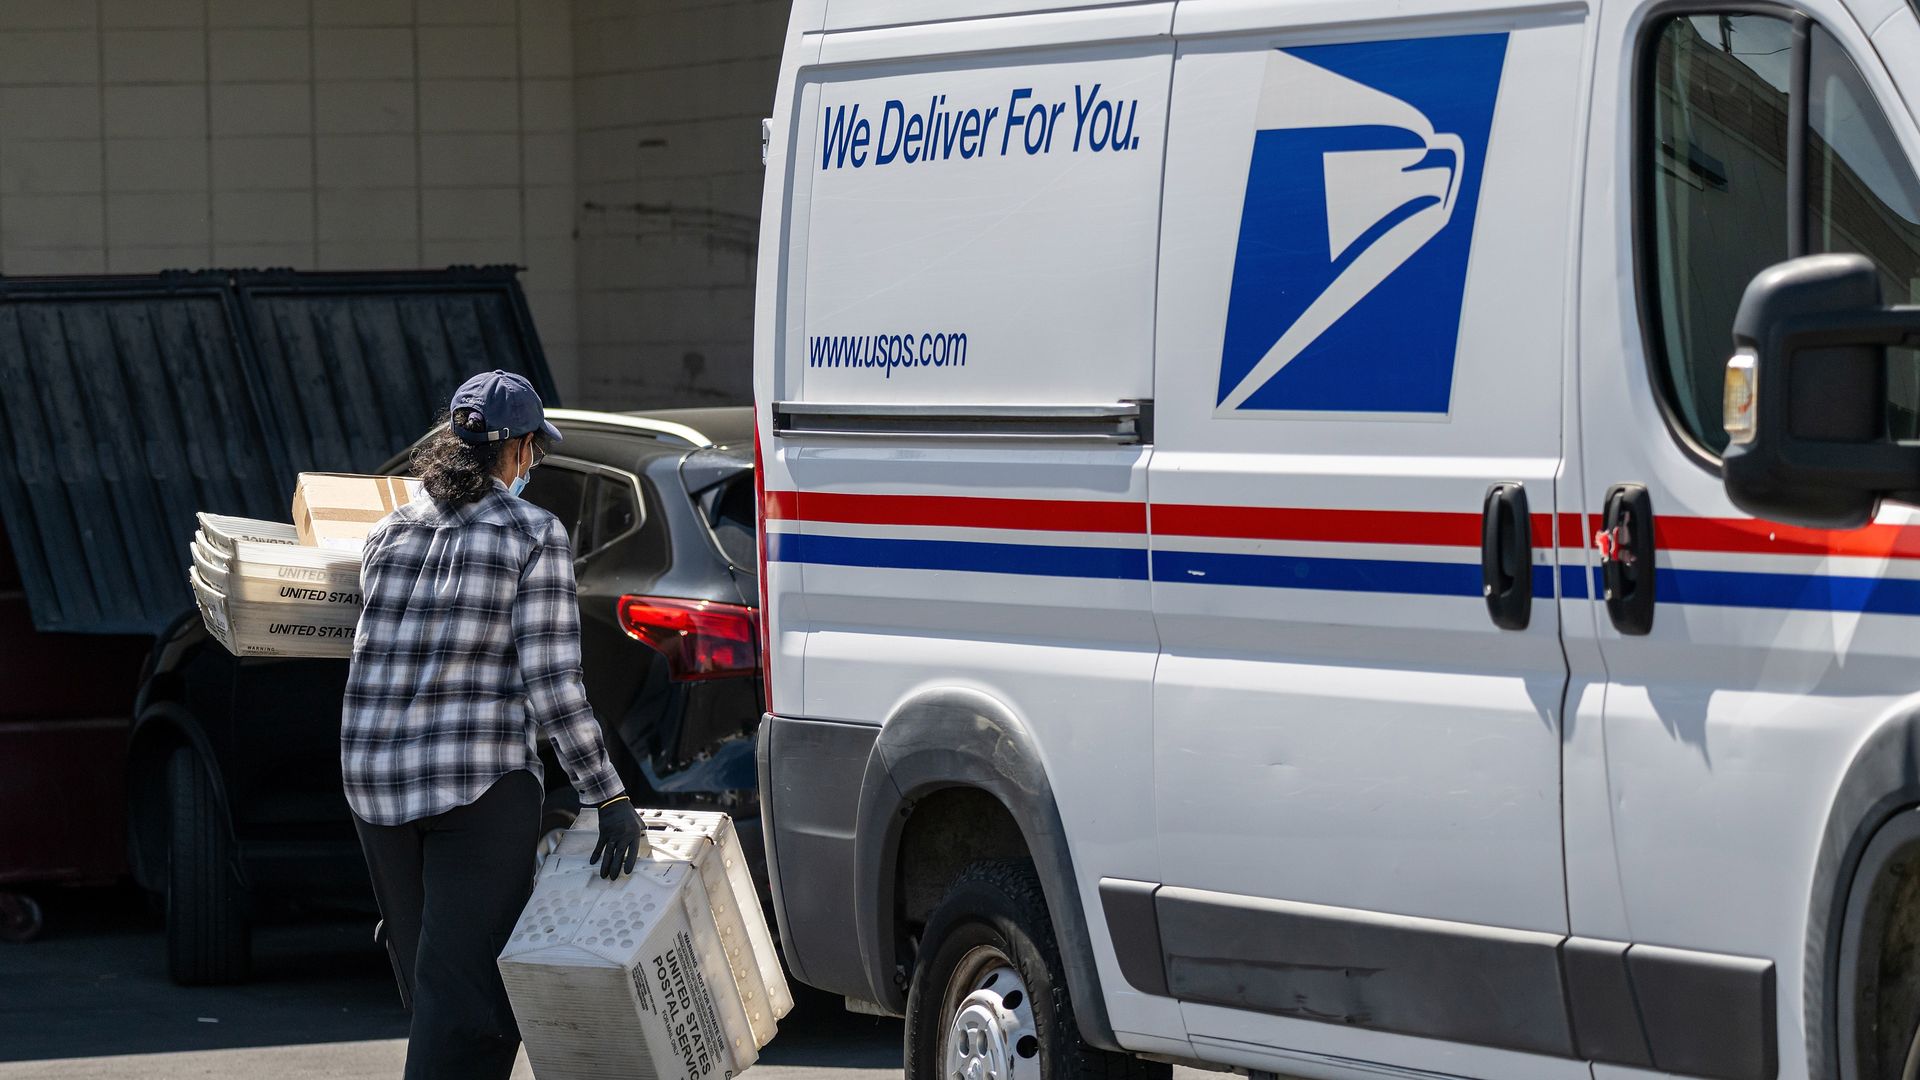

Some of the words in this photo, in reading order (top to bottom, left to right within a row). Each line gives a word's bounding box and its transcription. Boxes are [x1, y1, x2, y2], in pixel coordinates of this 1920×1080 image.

[822, 103, 871, 170] We
[875, 94, 999, 165] Deliver
[1000, 87, 1066, 156] For
[1072, 83, 1140, 153] You.
[809, 332, 968, 379] www.usps.com
[280, 586, 327, 601] UNITED
[269, 623, 316, 636] UNITED
[652, 954, 680, 1023] POSTAL
[684, 931, 698, 967] WARNING
[696, 971, 705, 988] NOT
[702, 988, 710, 1004] FOR
[665, 949, 691, 1010] UNITED
[686, 1012, 711, 1076] STATES
